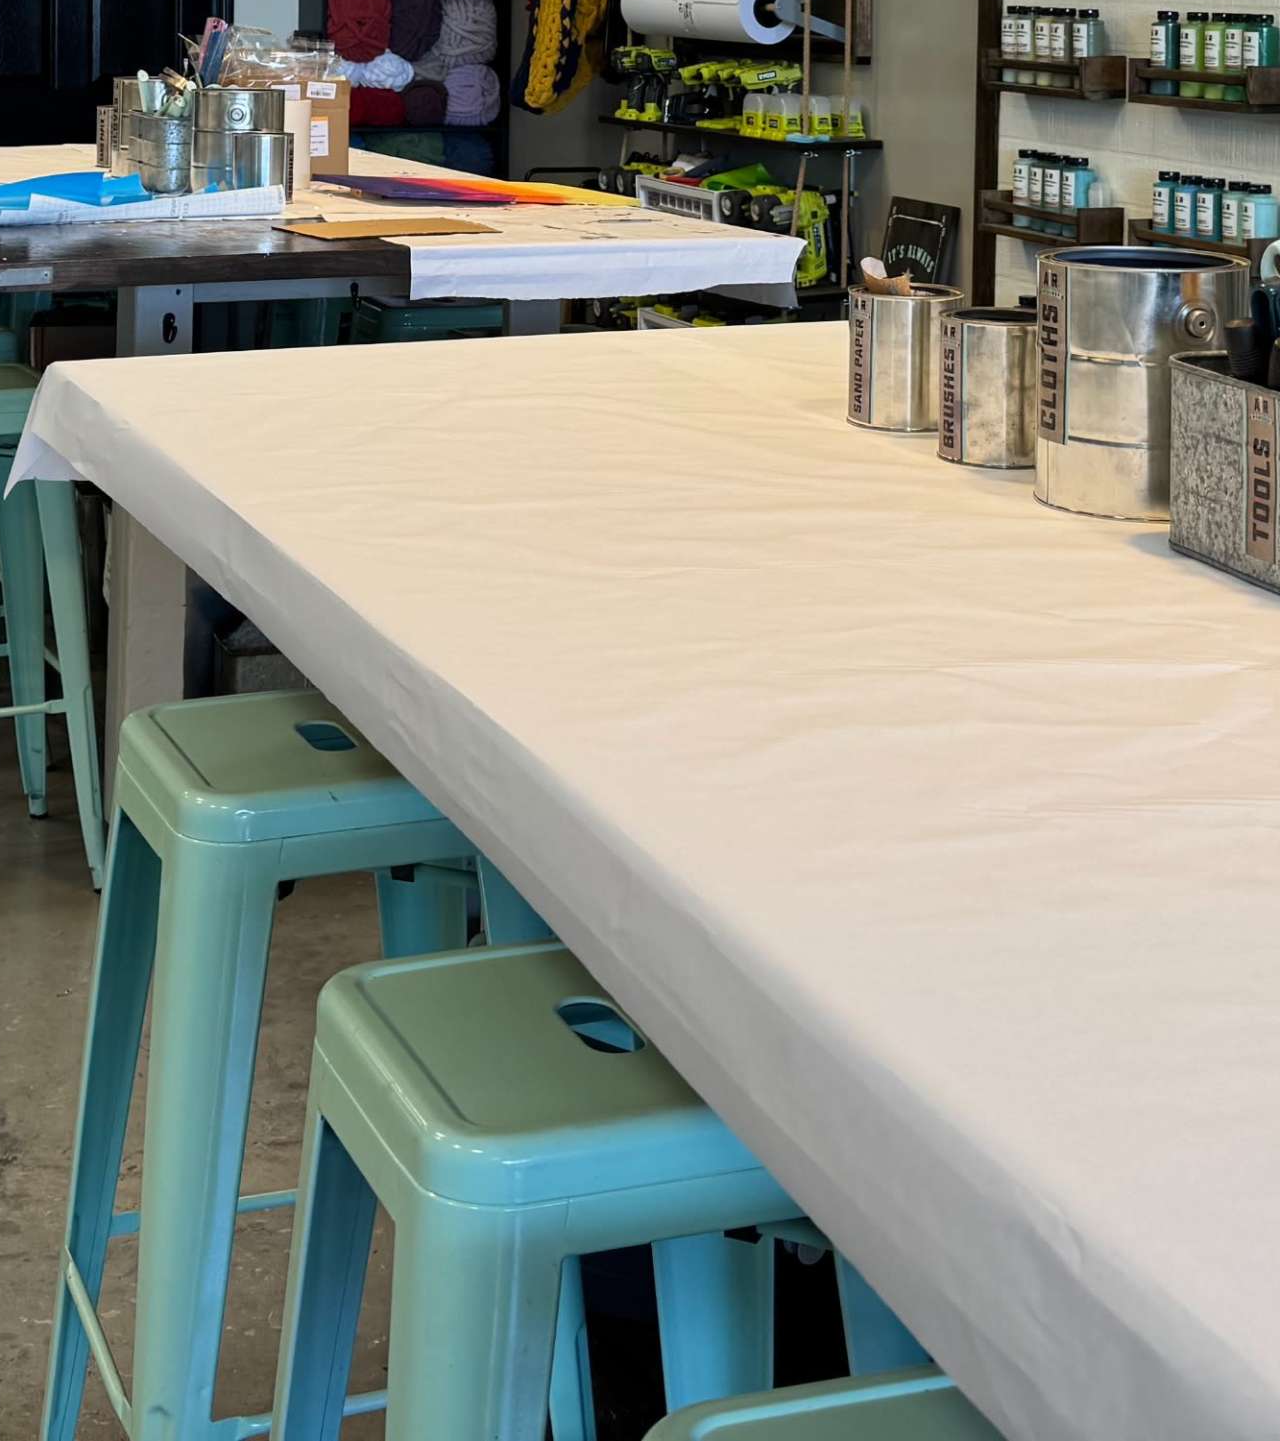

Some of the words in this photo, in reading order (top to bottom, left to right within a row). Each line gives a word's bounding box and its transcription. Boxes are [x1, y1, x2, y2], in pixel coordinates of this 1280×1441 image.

[888, 244, 905, 264] IT'S
[907, 244, 935, 273] ALWAYS
[854, 319, 864, 368] PAPER
[1041, 304, 1059, 431] CLOTHS
[853, 375, 863, 413] SAND
[943, 348, 955, 449] BRUSHES
[1252, 438, 1270, 541] TOOLS
